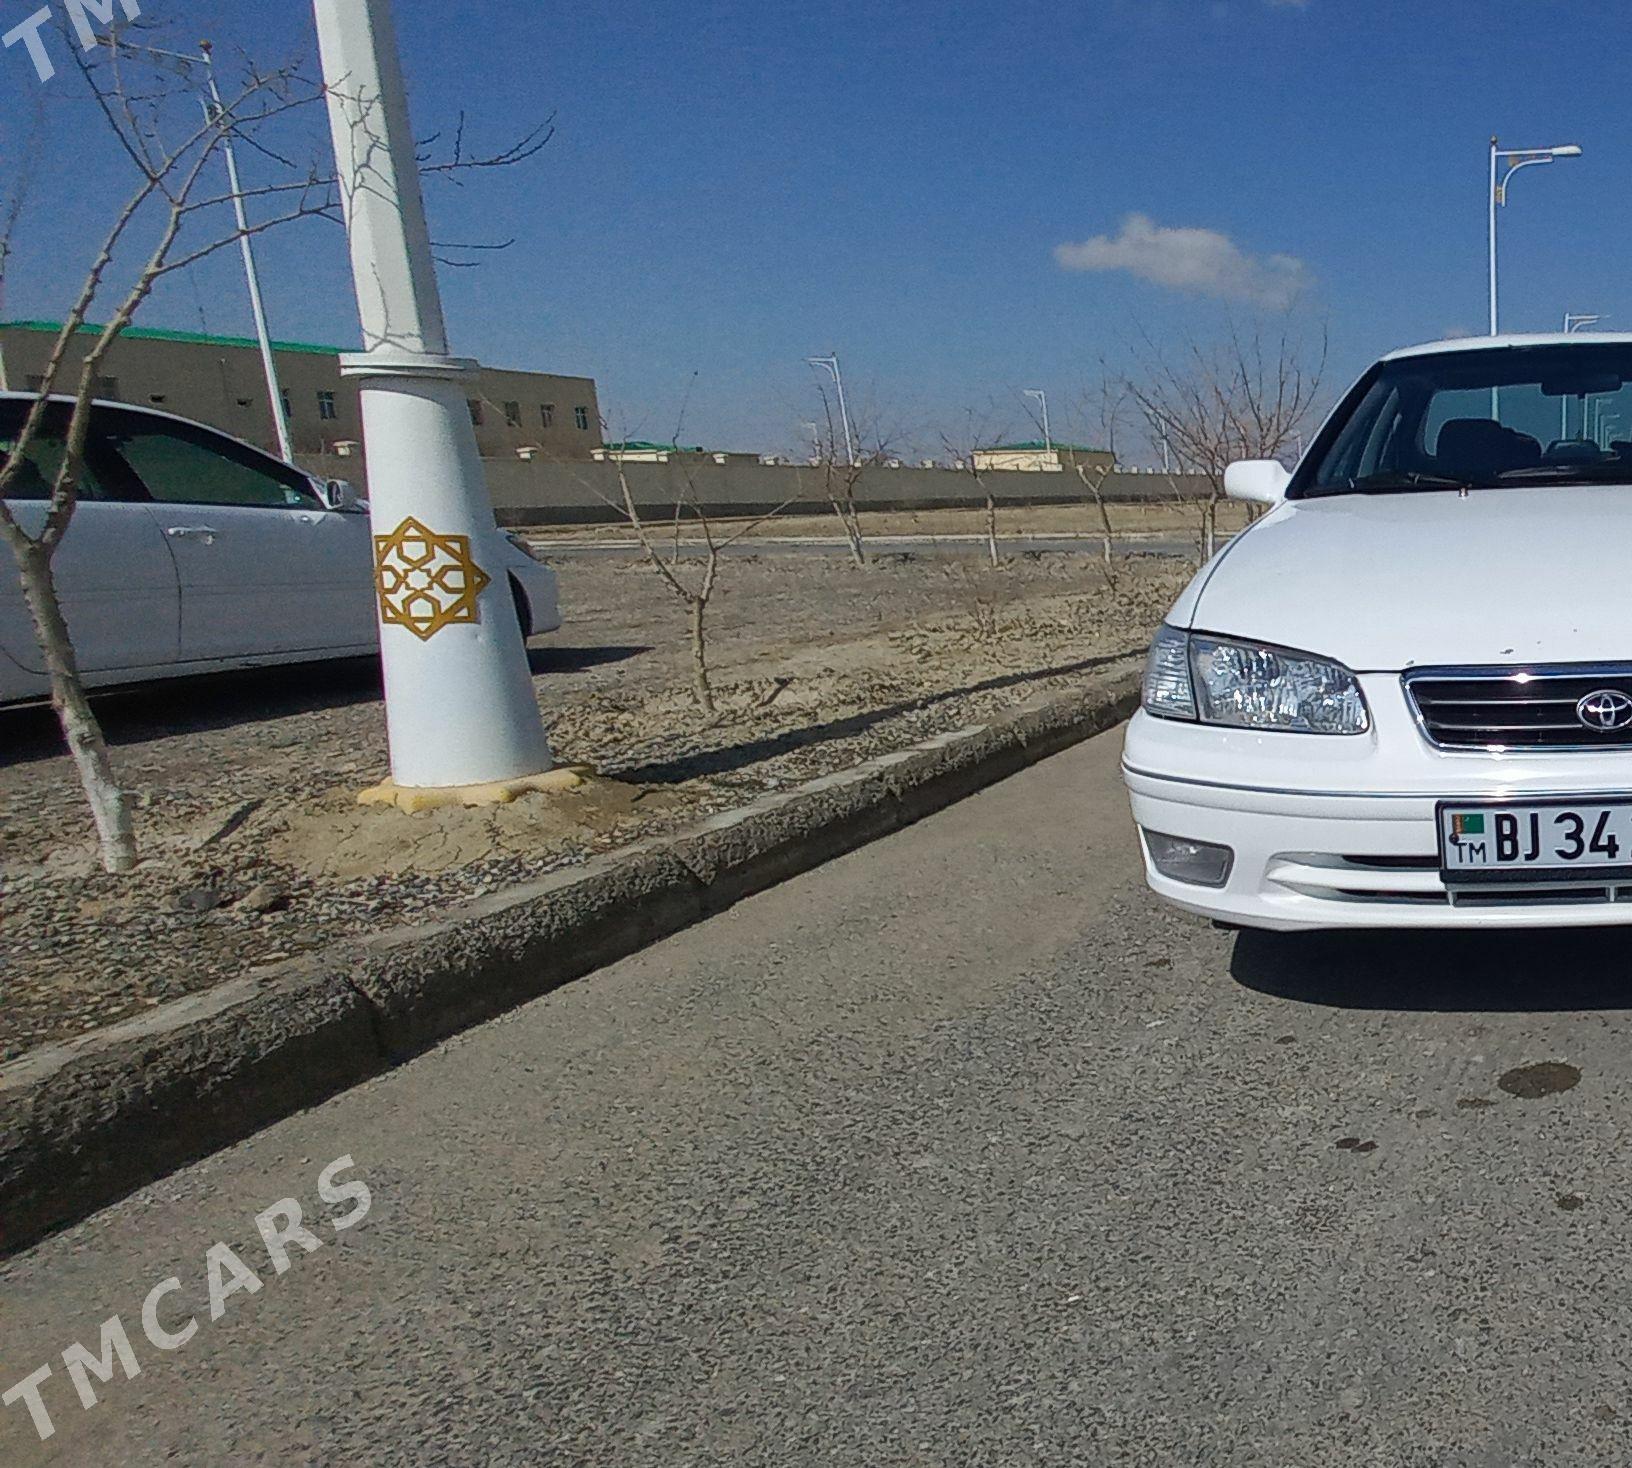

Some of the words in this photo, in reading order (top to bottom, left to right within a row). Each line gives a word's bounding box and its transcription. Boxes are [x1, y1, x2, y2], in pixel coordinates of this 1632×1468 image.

[1457, 841, 1487, 863] TM
[1494, 812, 1539, 861] BJ
[1553, 810, 1620, 860] 34
